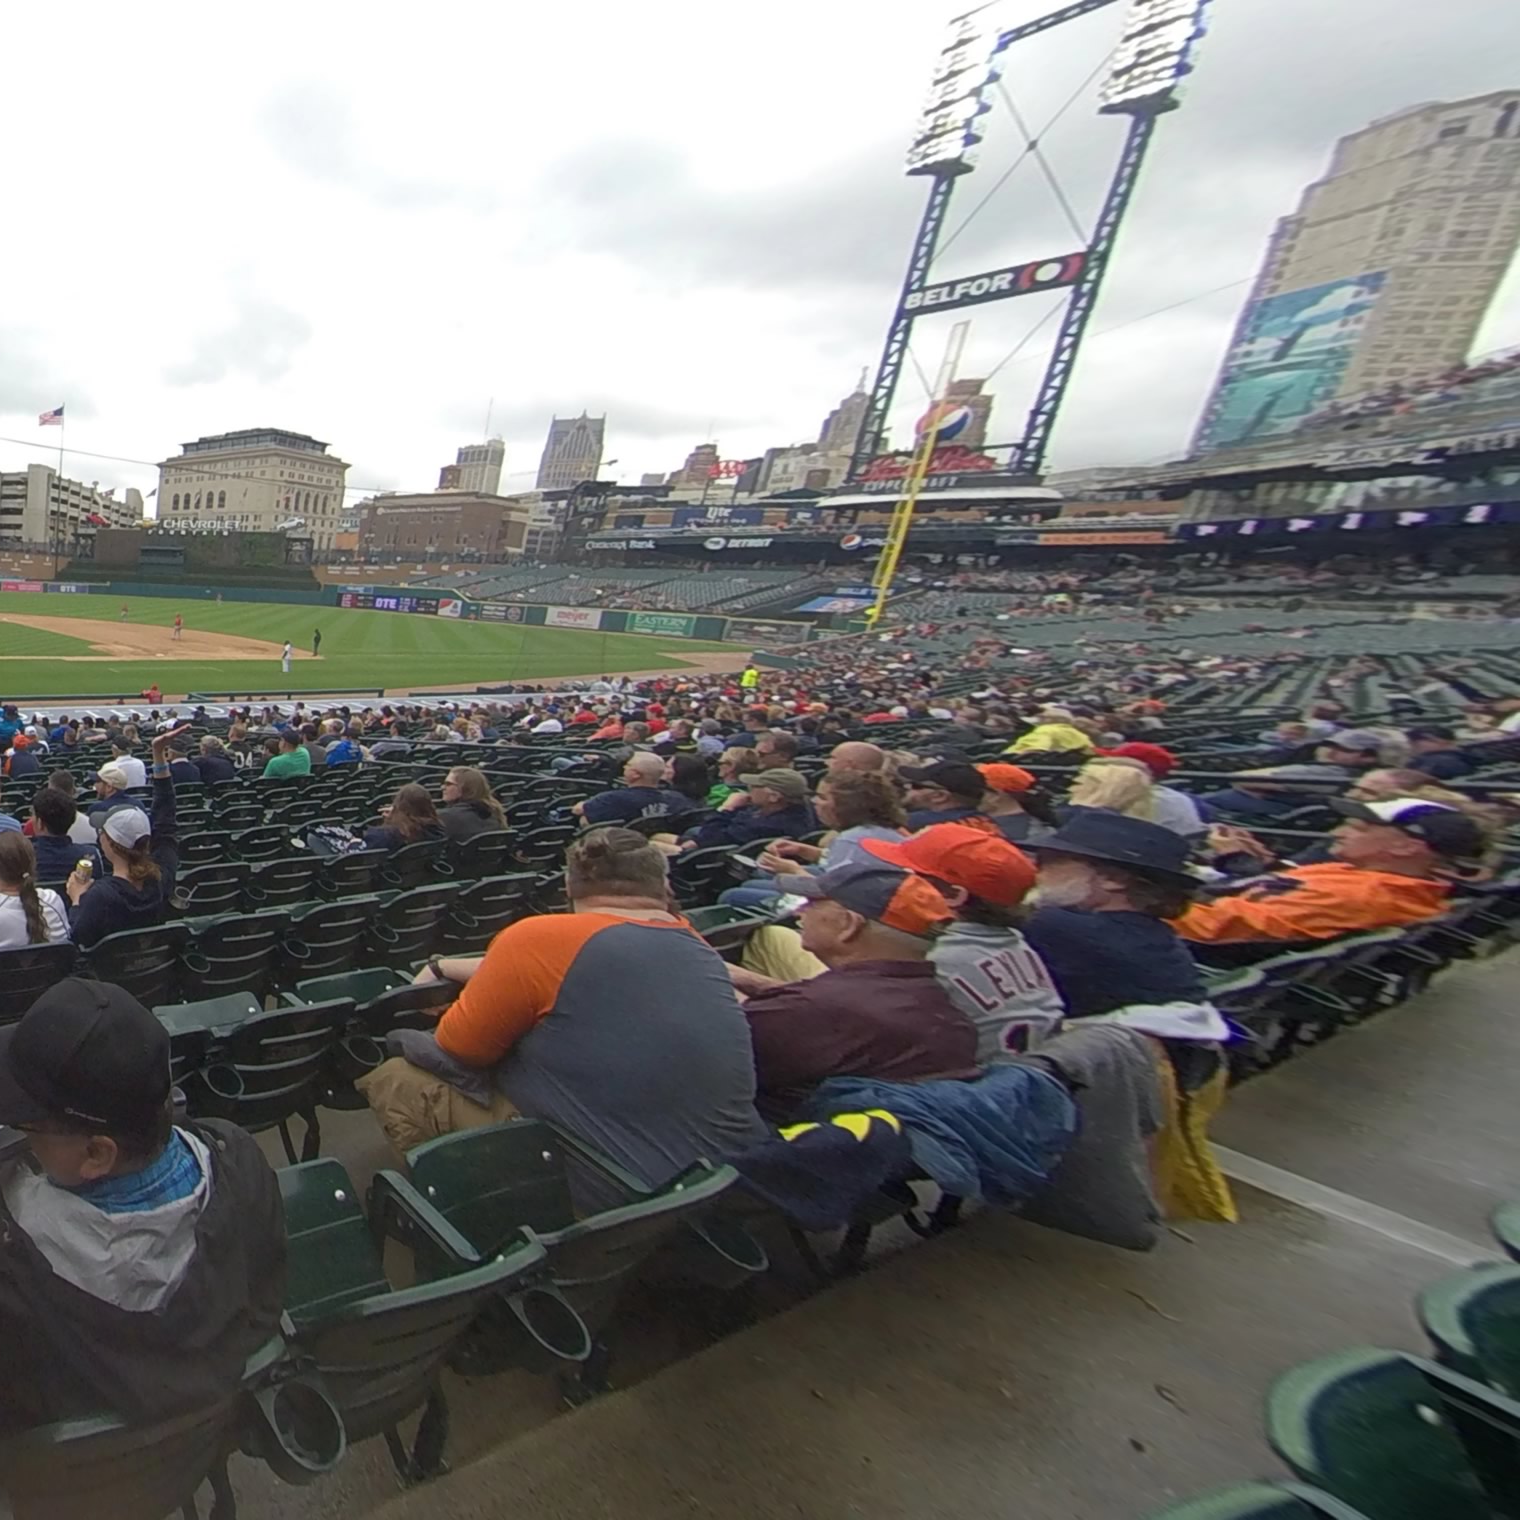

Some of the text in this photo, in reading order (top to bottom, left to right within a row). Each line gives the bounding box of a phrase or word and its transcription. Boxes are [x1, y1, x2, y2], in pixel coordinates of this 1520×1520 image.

[904, 272, 1015, 310] BELFOR
[162, 520, 240, 529] CHEVROLET
[727, 538, 773, 548] DETROIT
[375, 597, 397, 609] DTE
[635, 613, 688, 626] EASTERN
